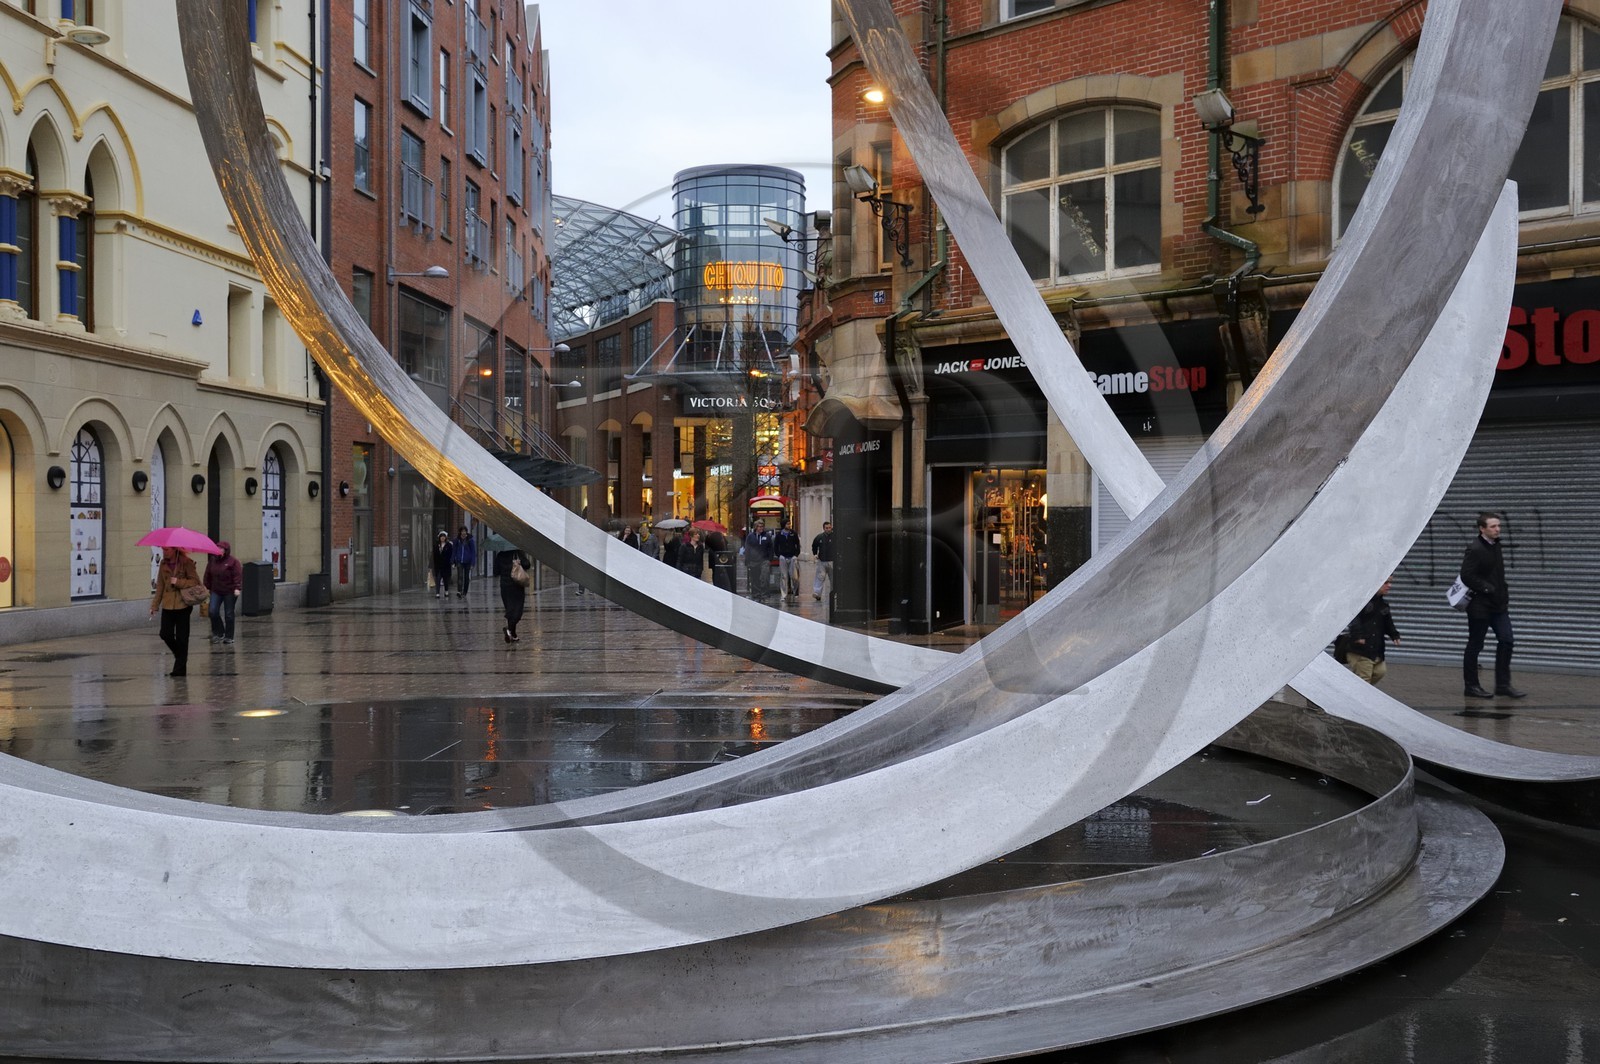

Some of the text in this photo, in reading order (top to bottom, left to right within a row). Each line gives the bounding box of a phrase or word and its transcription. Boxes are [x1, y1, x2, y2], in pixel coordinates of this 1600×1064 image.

[703, 260, 784, 292] CHIQUITO
[934, 360, 970, 375] JACK
[689, 397, 748, 408] VICTORIA
[839, 439, 881, 456] JACK JONES
